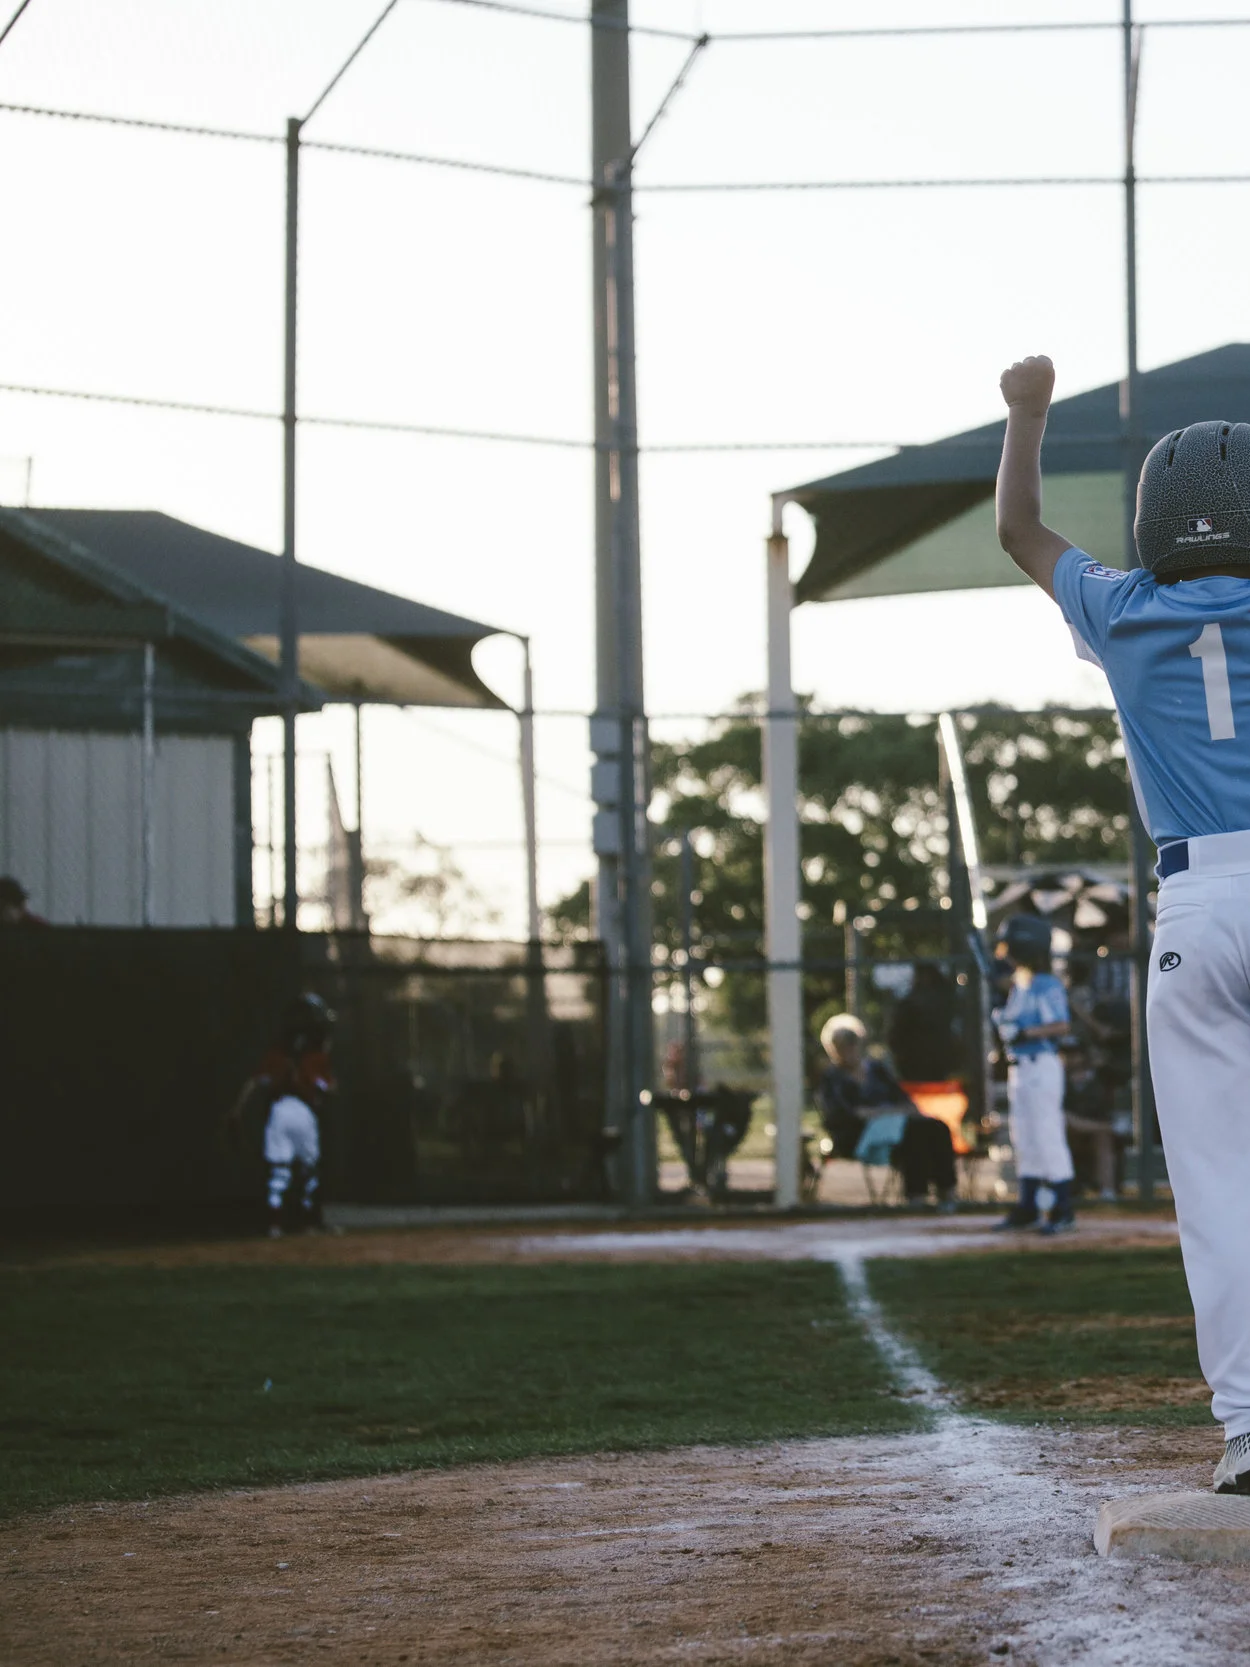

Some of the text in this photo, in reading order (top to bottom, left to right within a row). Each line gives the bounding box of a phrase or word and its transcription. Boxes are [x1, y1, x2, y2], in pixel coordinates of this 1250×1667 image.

[1176, 532, 1230, 543] RAWLINGS
[1188, 622, 1236, 741] 1
[1160, 953, 1176, 970] R
